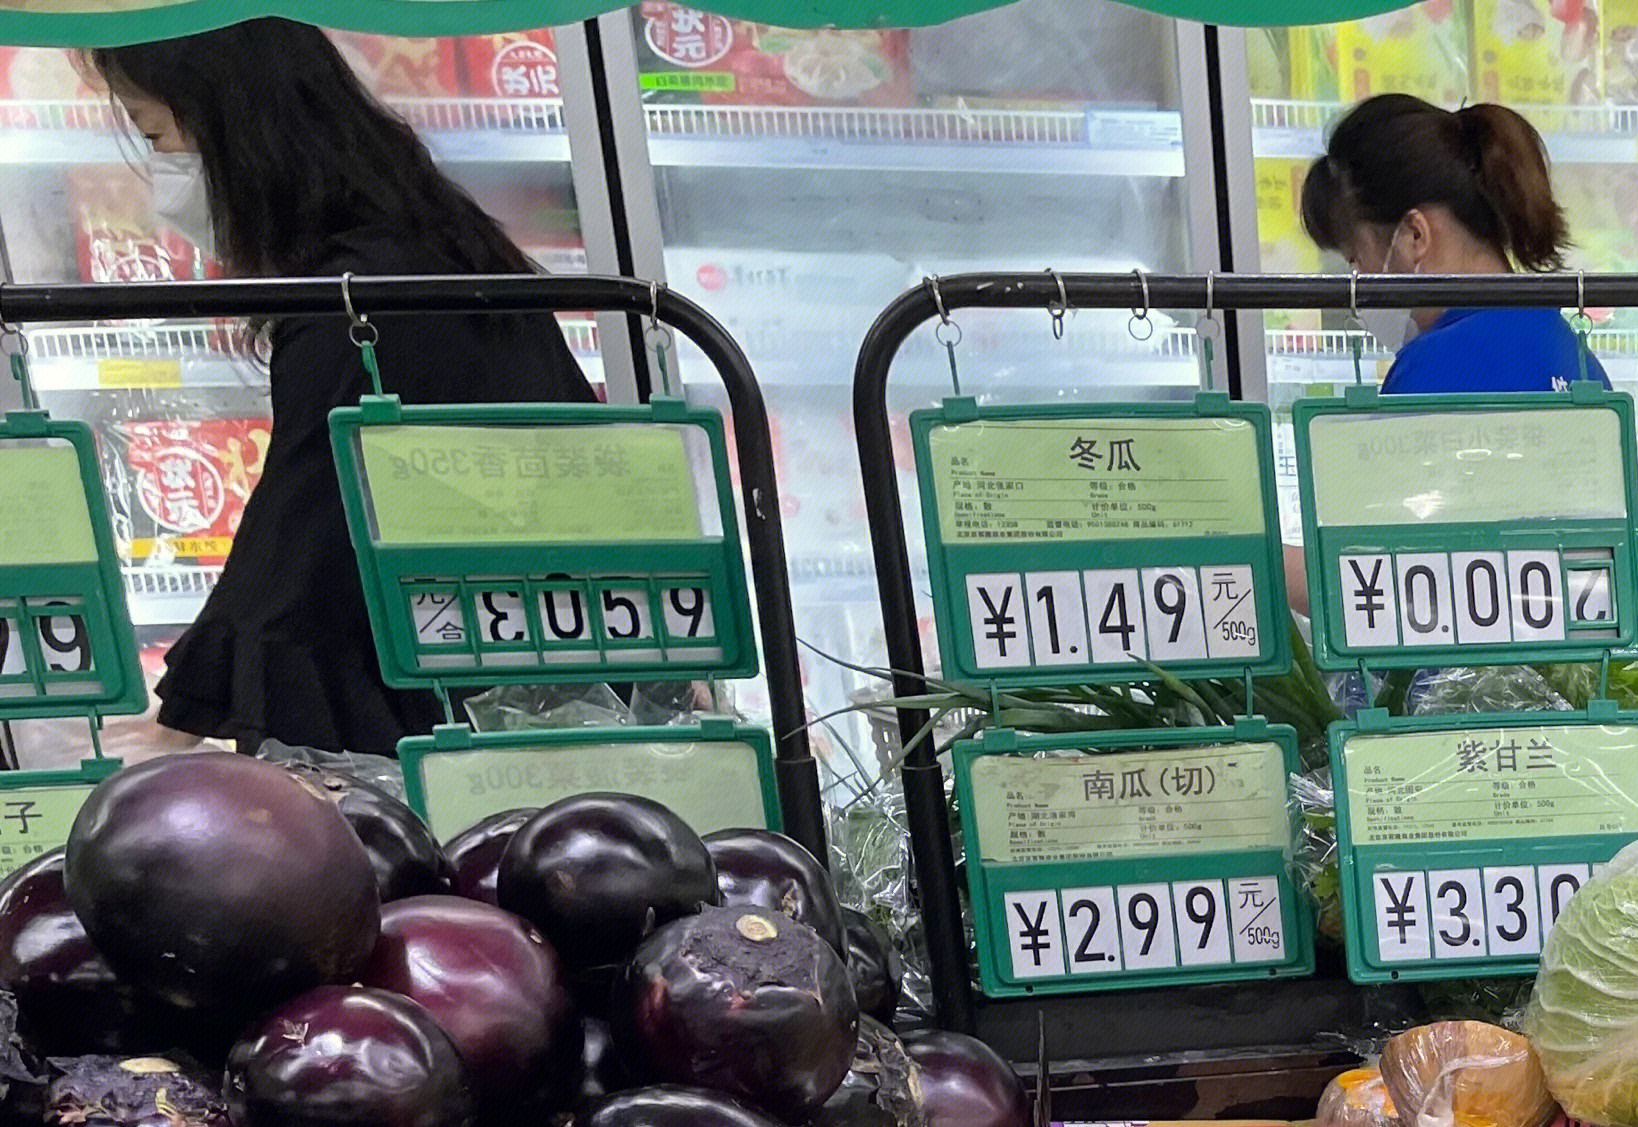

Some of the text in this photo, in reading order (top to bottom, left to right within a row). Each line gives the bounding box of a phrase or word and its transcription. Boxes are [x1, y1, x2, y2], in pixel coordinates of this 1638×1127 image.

[1070, 436, 1141, 472] 冬瓜
[976, 574, 1187, 657] ¥1.49
[1456, 738, 1557, 773] 紫甘兰
[0, 802, 42, 834] 子
[1013, 886, 1216, 966] ¥2.99
